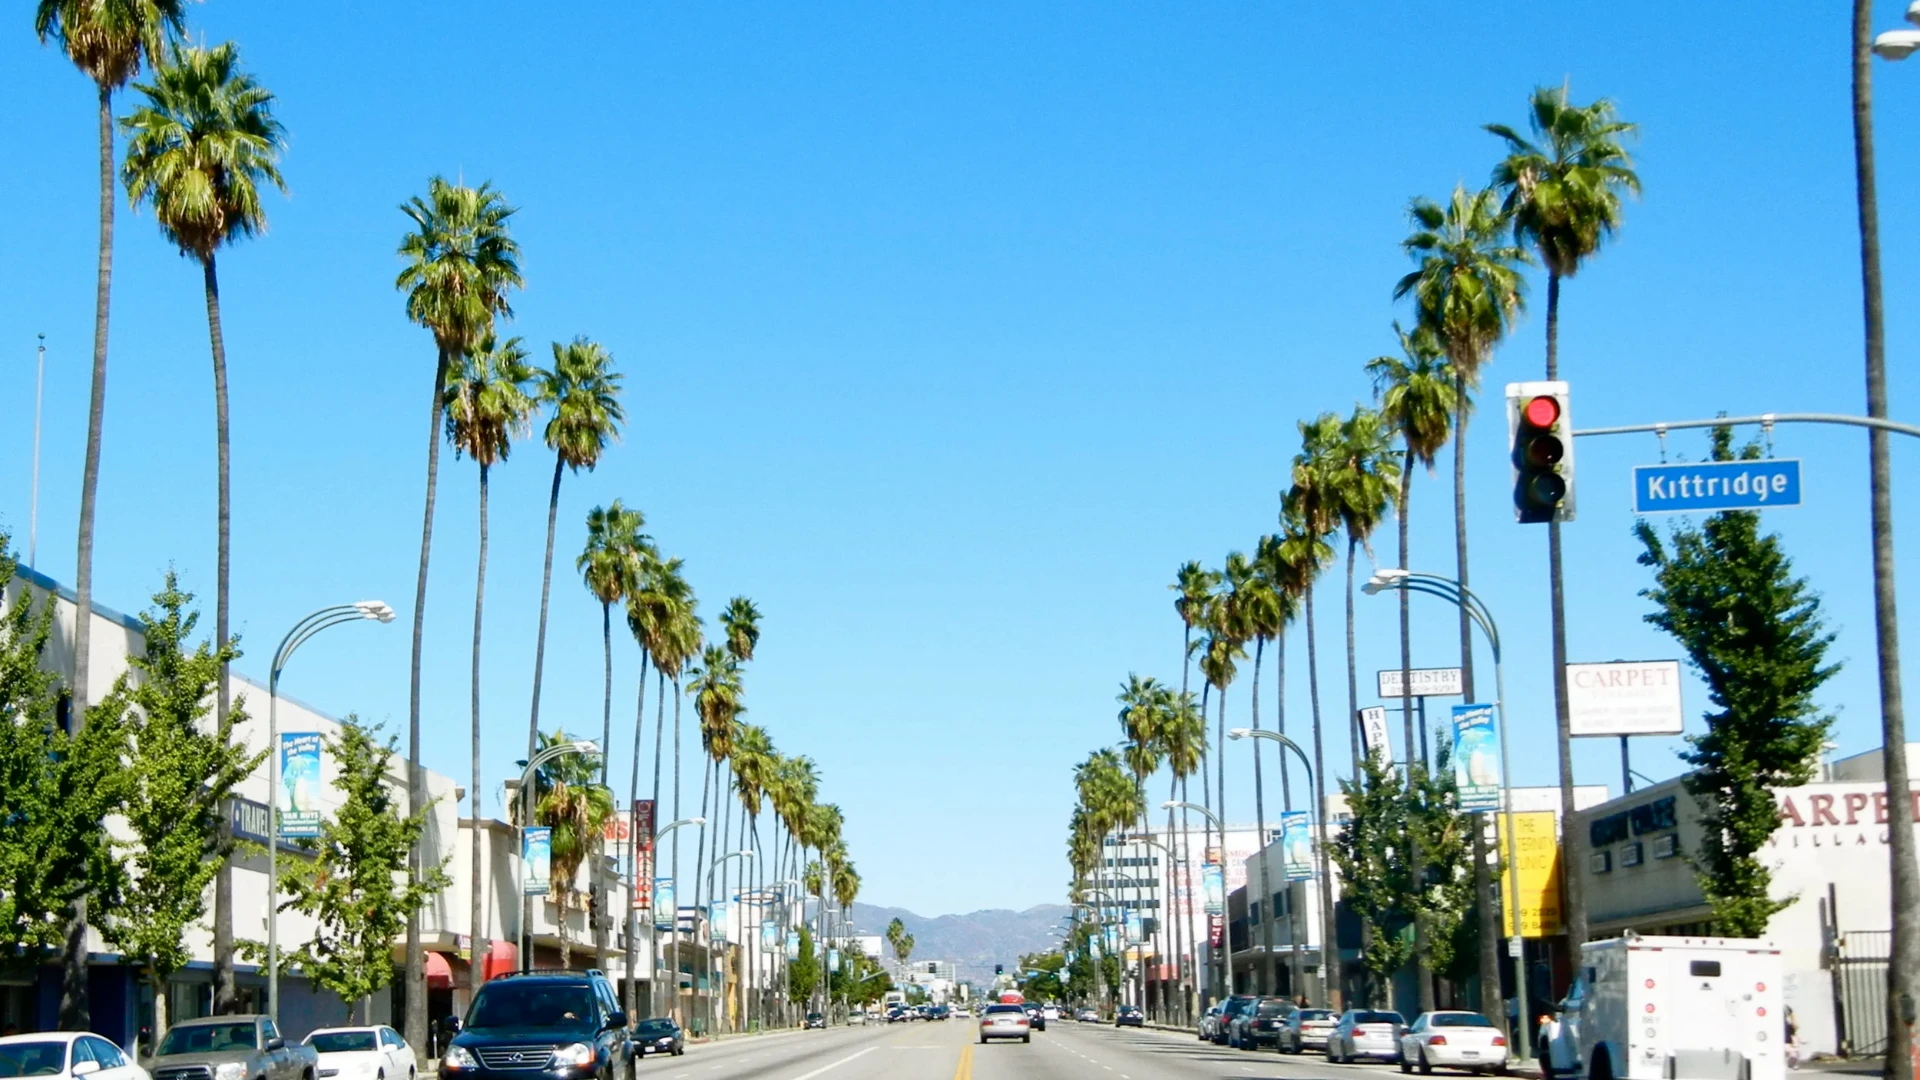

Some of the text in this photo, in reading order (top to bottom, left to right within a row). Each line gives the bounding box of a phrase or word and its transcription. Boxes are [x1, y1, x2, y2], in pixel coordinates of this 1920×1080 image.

[1648, 472, 1788, 502] Kittridge
[1382, 670, 1458, 685] DETISTRY
[1574, 667, 1672, 689] CARPET
[240, 802, 269, 837] TRAVEL
[1518, 818, 1535, 832] THE
[1769, 831, 1890, 848] VILLAG
[1510, 854, 1548, 870] LINIC
